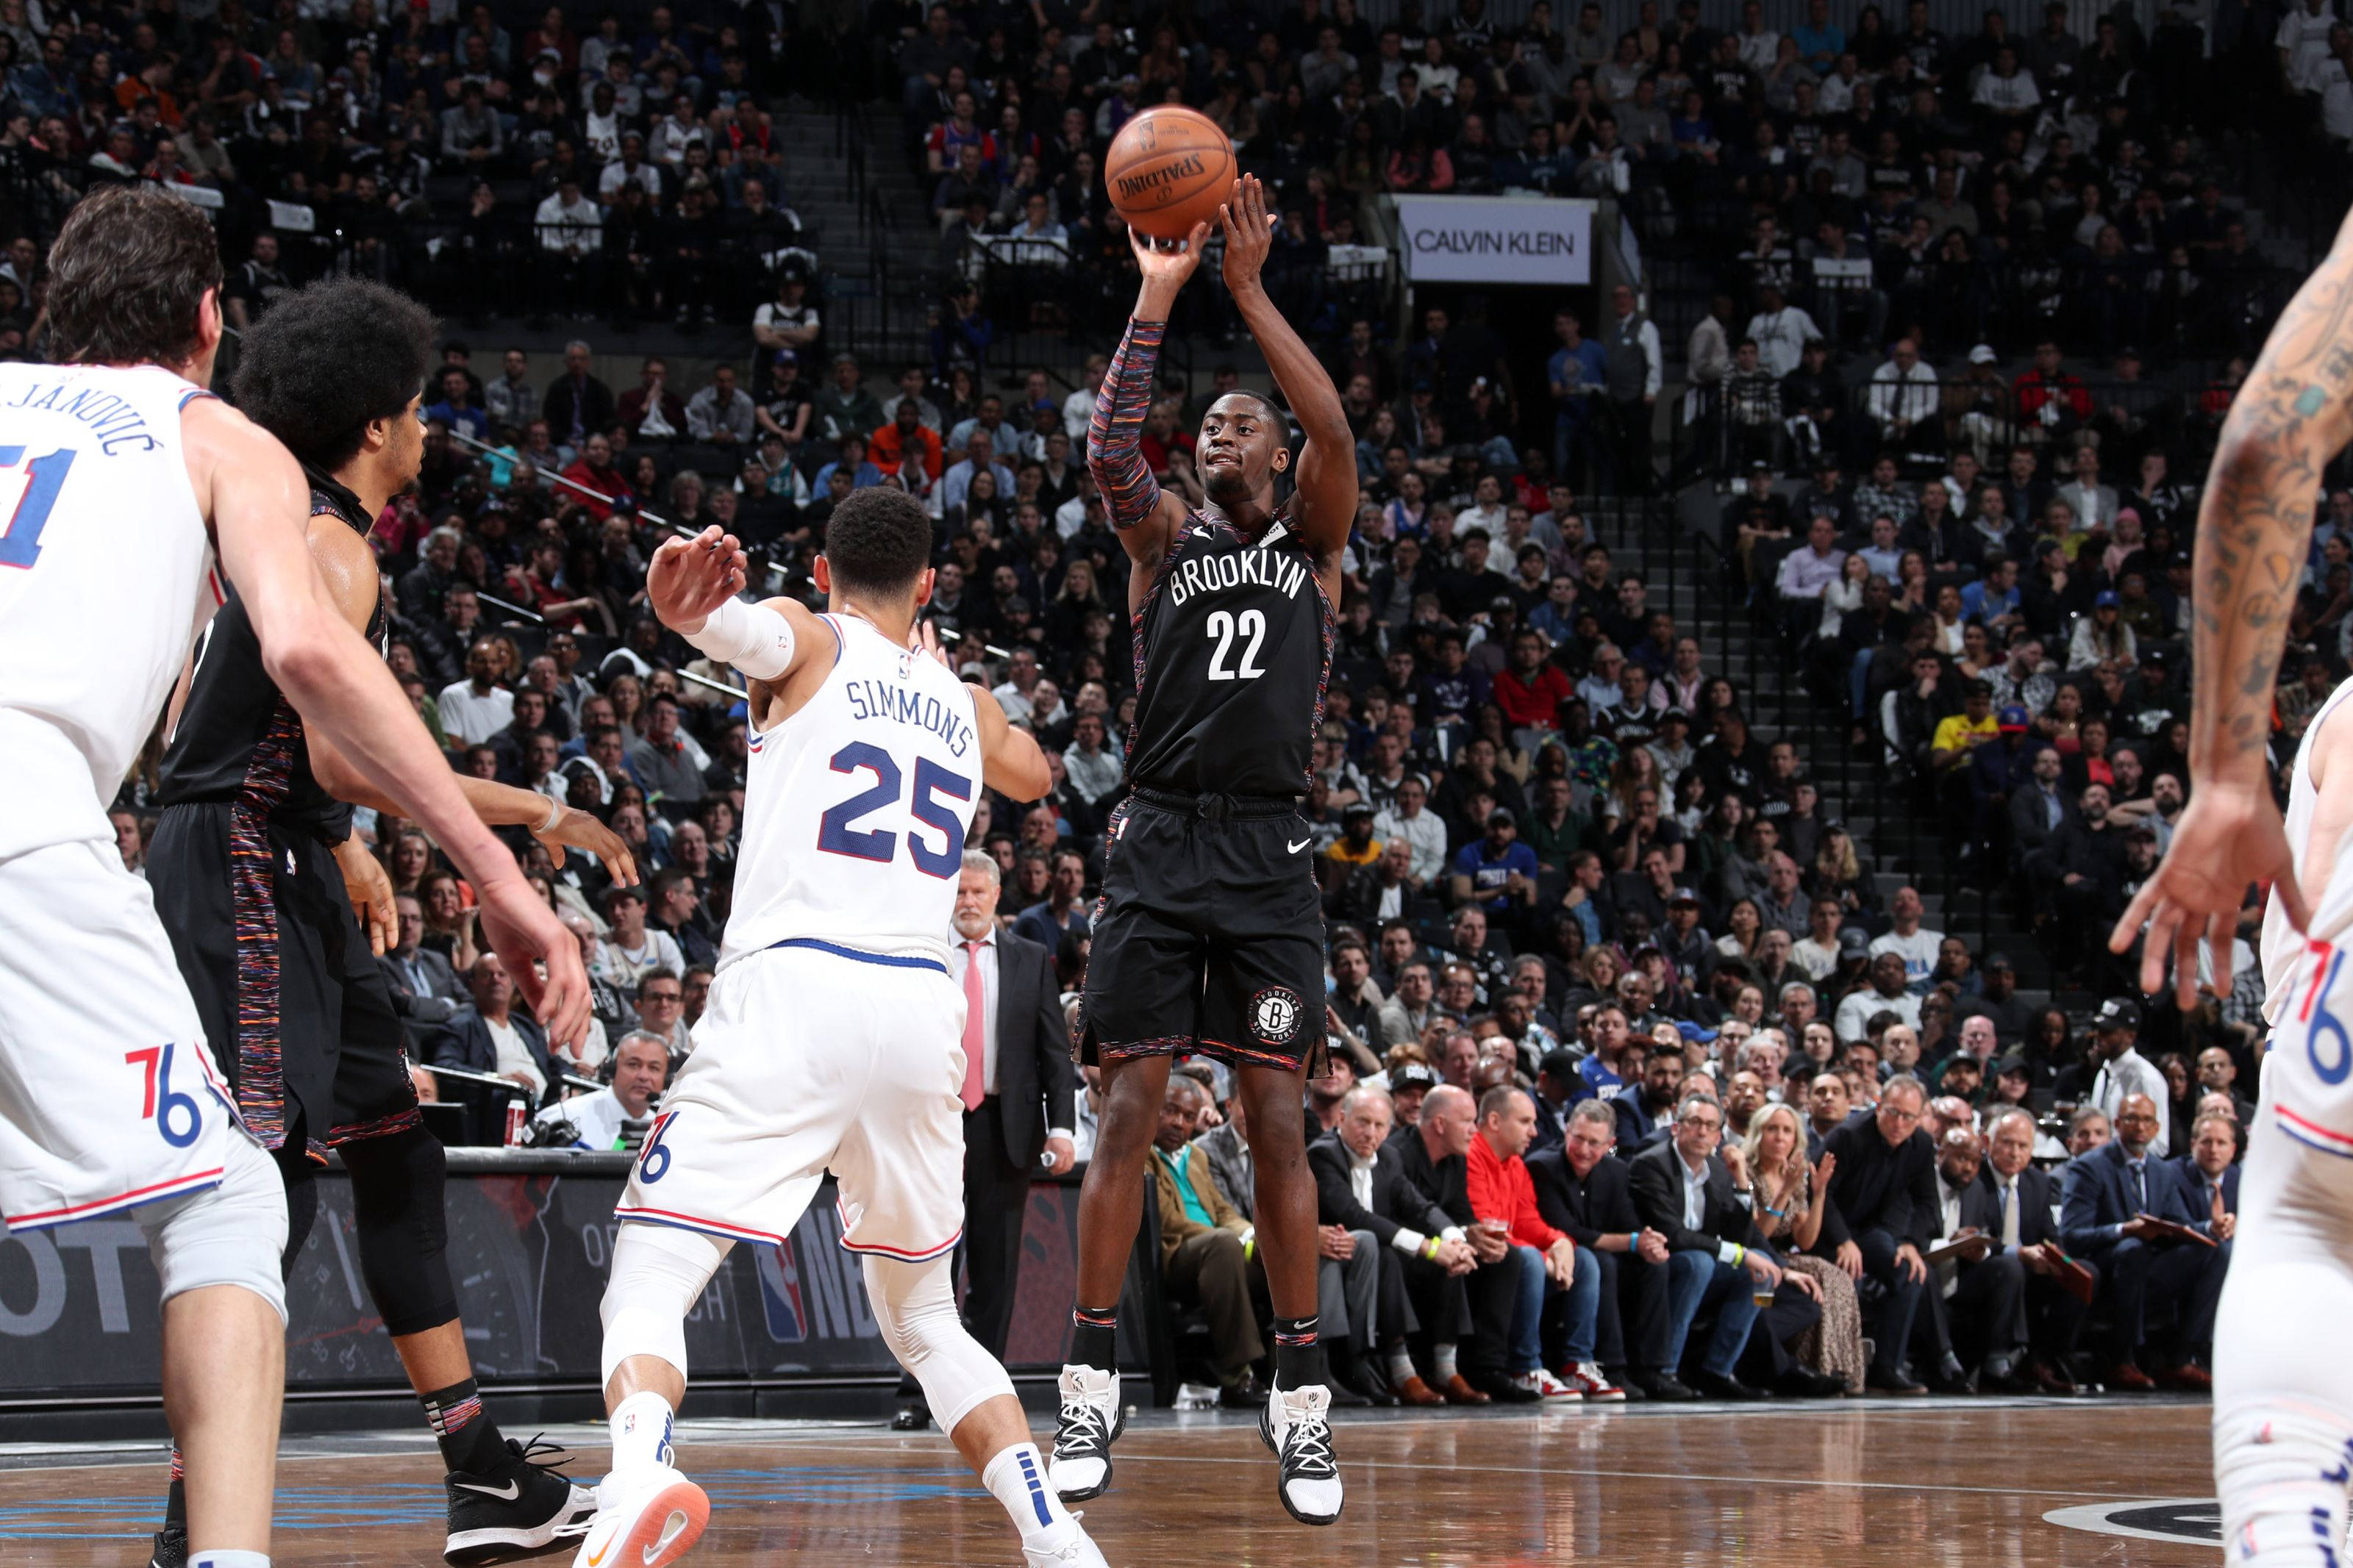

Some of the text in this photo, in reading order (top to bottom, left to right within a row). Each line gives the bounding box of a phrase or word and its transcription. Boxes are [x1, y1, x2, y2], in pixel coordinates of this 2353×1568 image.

[1118, 152, 1206, 201] SPALDING
[1415, 229, 1574, 255] CALVIN KLEIN
[0, 445, 77, 570] 1
[1170, 549, 1307, 606] BROOKLYN
[1207, 609, 1266, 681] 22
[846, 680, 973, 758] SIMMONS
[817, 741, 971, 880] 25
[1253, 1021, 1294, 1040] NEW YORK
[1256, 990, 1299, 1012] BROOKLYN
[1268, 1002, 1282, 1028] B
[2298, 938, 2352, 1086] 76
[125, 1042, 202, 1148] 76
[638, 1111, 681, 1185] 76
